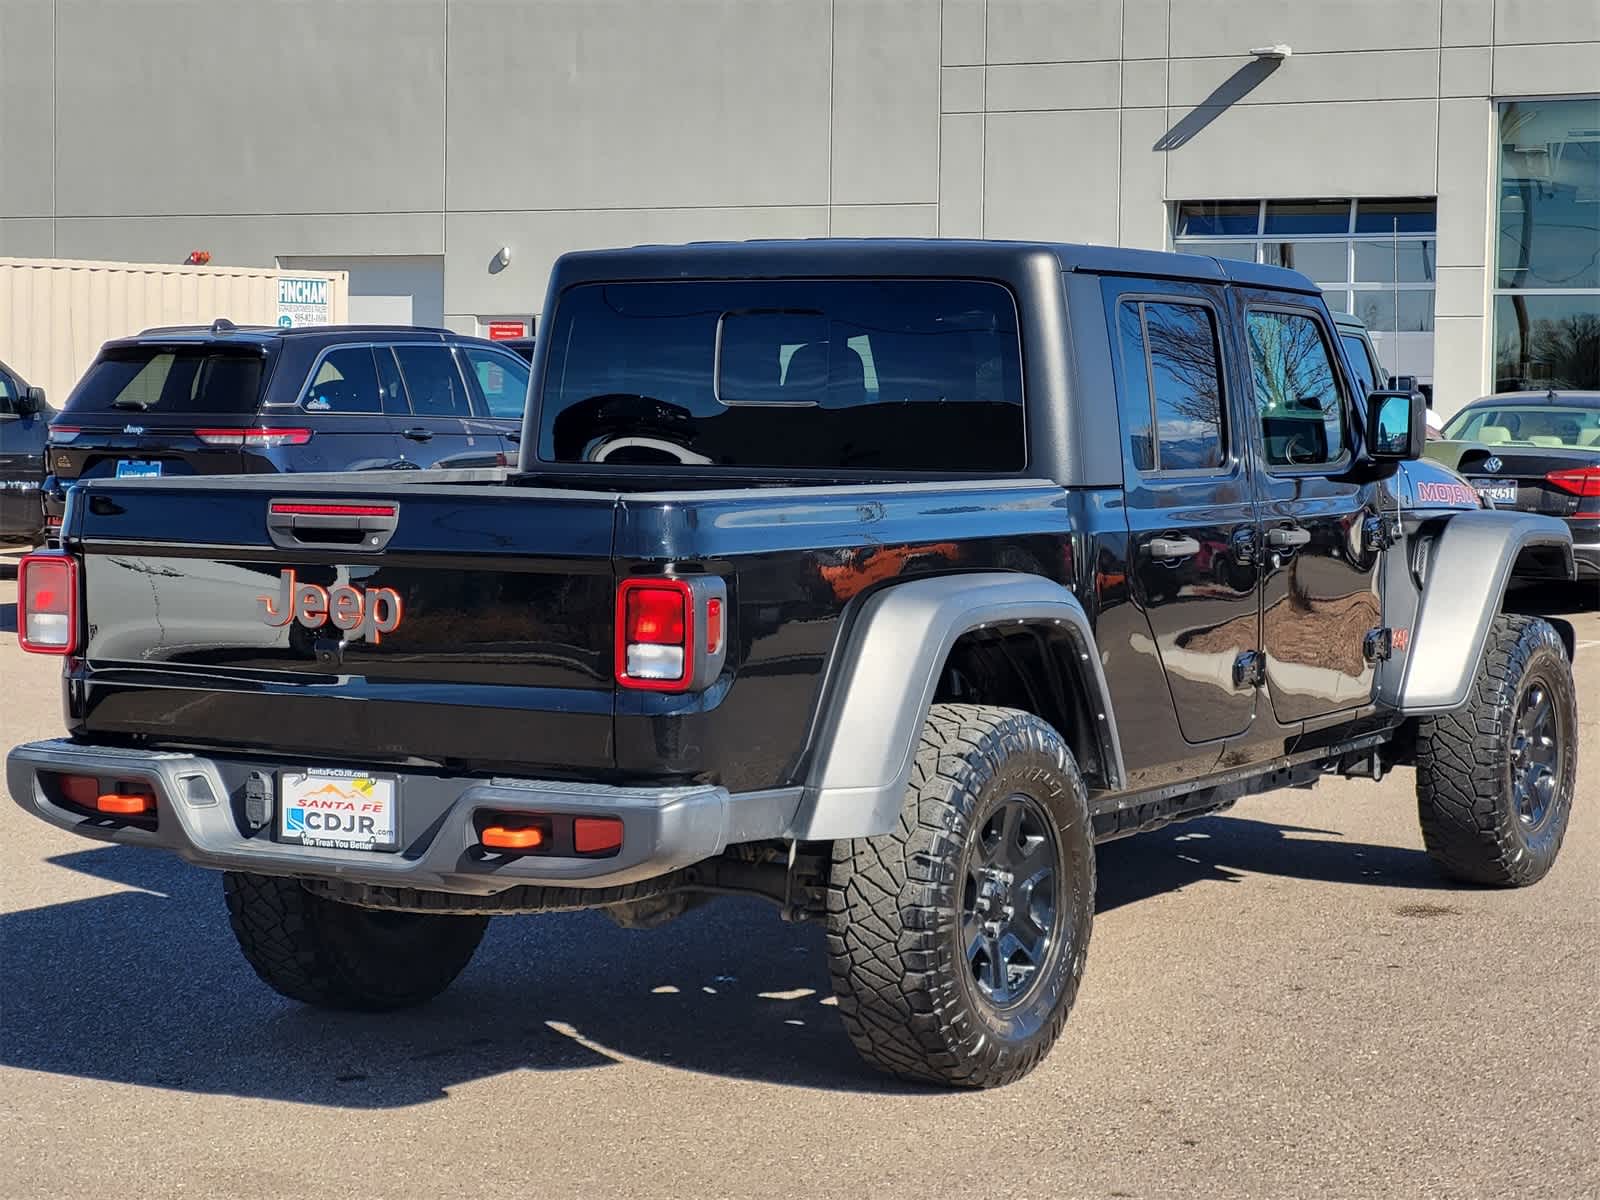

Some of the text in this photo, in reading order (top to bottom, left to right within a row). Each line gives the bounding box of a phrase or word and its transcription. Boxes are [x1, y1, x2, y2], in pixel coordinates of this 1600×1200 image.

[279, 281, 326, 303] FINCHAM
[123, 424, 143, 435] Jeep
[1417, 482, 1482, 506] MOJAVE
[257, 568, 402, 644] Jeep
[297, 799, 384, 813] SANTA FE
[305, 811, 375, 835] CDJR
[302, 838, 314, 847] We
[335, 840, 349, 850] You
[350, 840, 375, 851] Better
